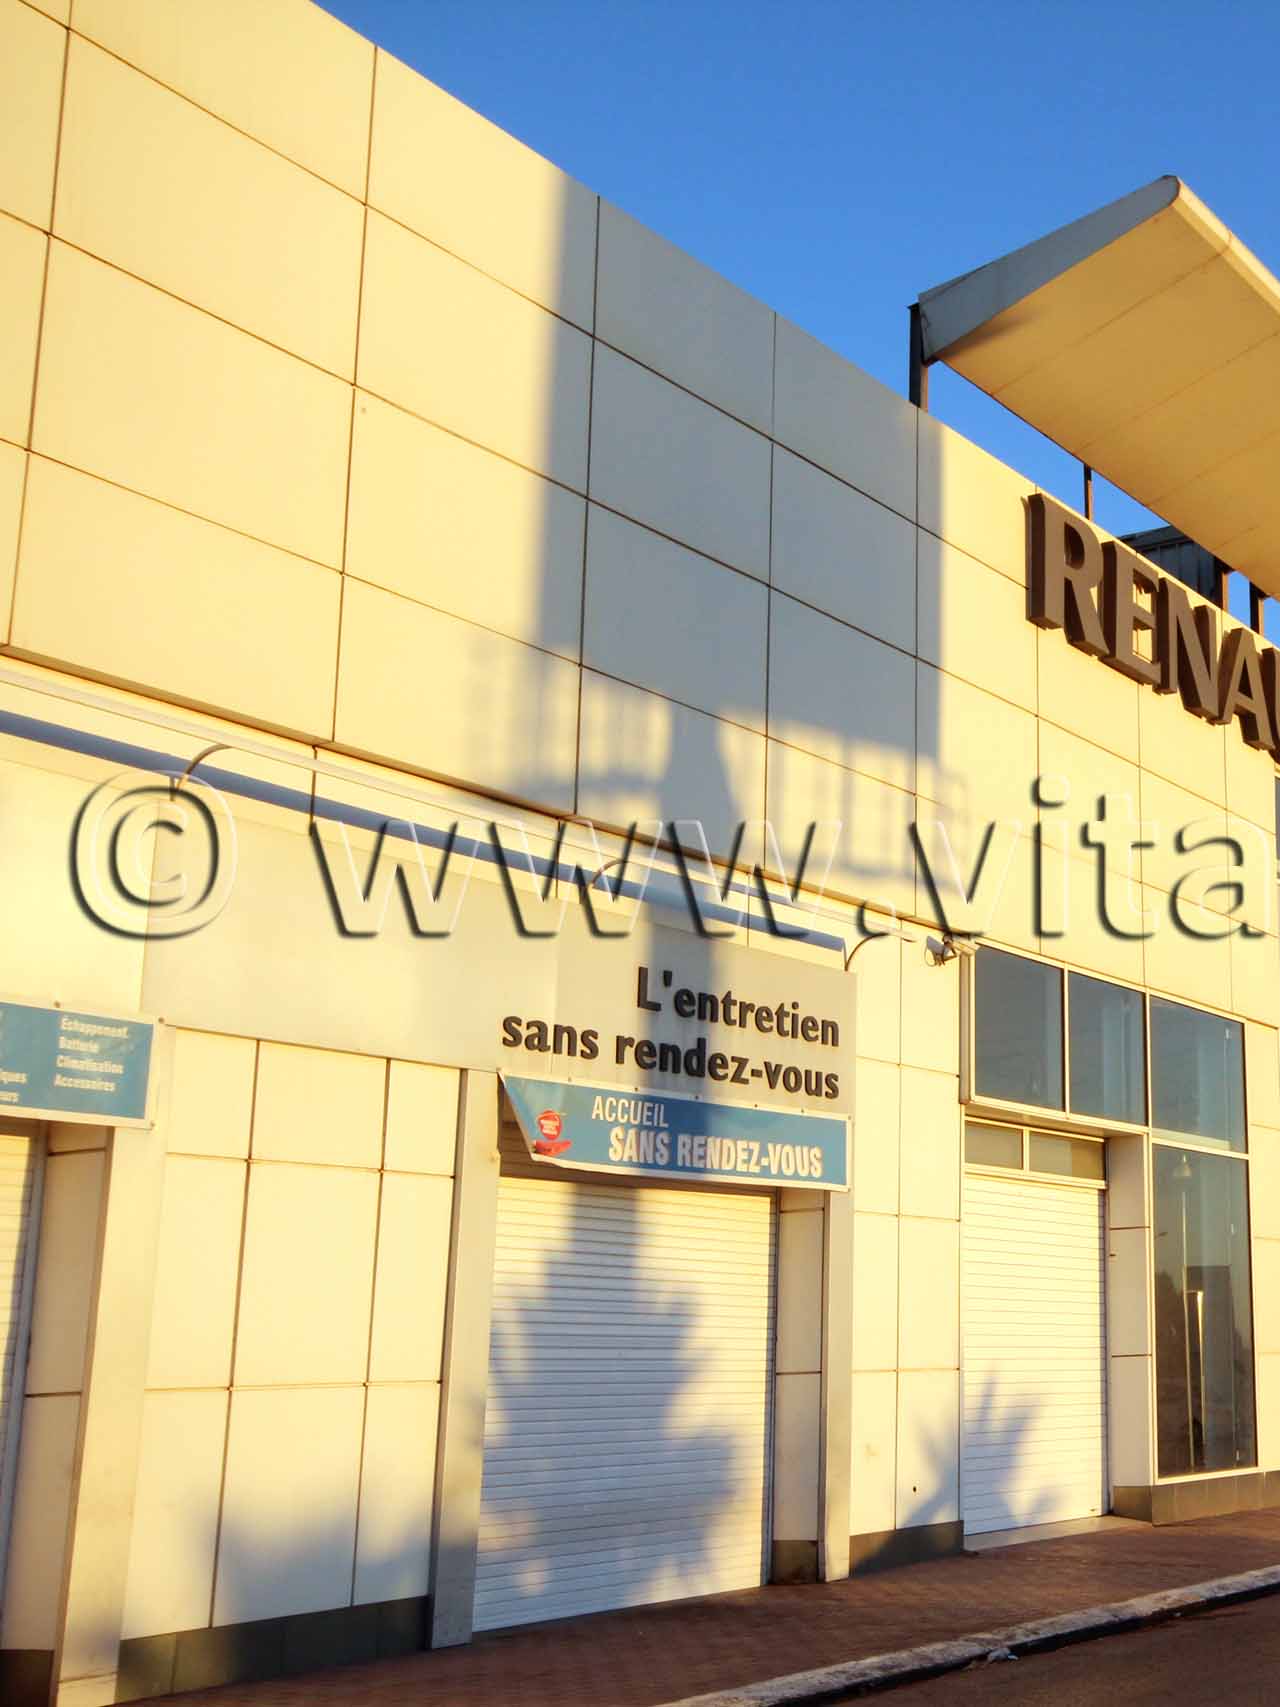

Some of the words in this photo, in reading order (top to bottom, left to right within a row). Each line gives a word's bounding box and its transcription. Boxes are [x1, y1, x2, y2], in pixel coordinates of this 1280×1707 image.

[637, 965, 841, 1048] L'entretien
[502, 1015, 599, 1060] sans
[615, 1034, 840, 1100] rendez-vous
[592, 1095, 669, 1129] ACCUEIL
[608, 1126, 672, 1166] SANS
[677, 1133, 824, 1179] RENDEZ-VOUS
